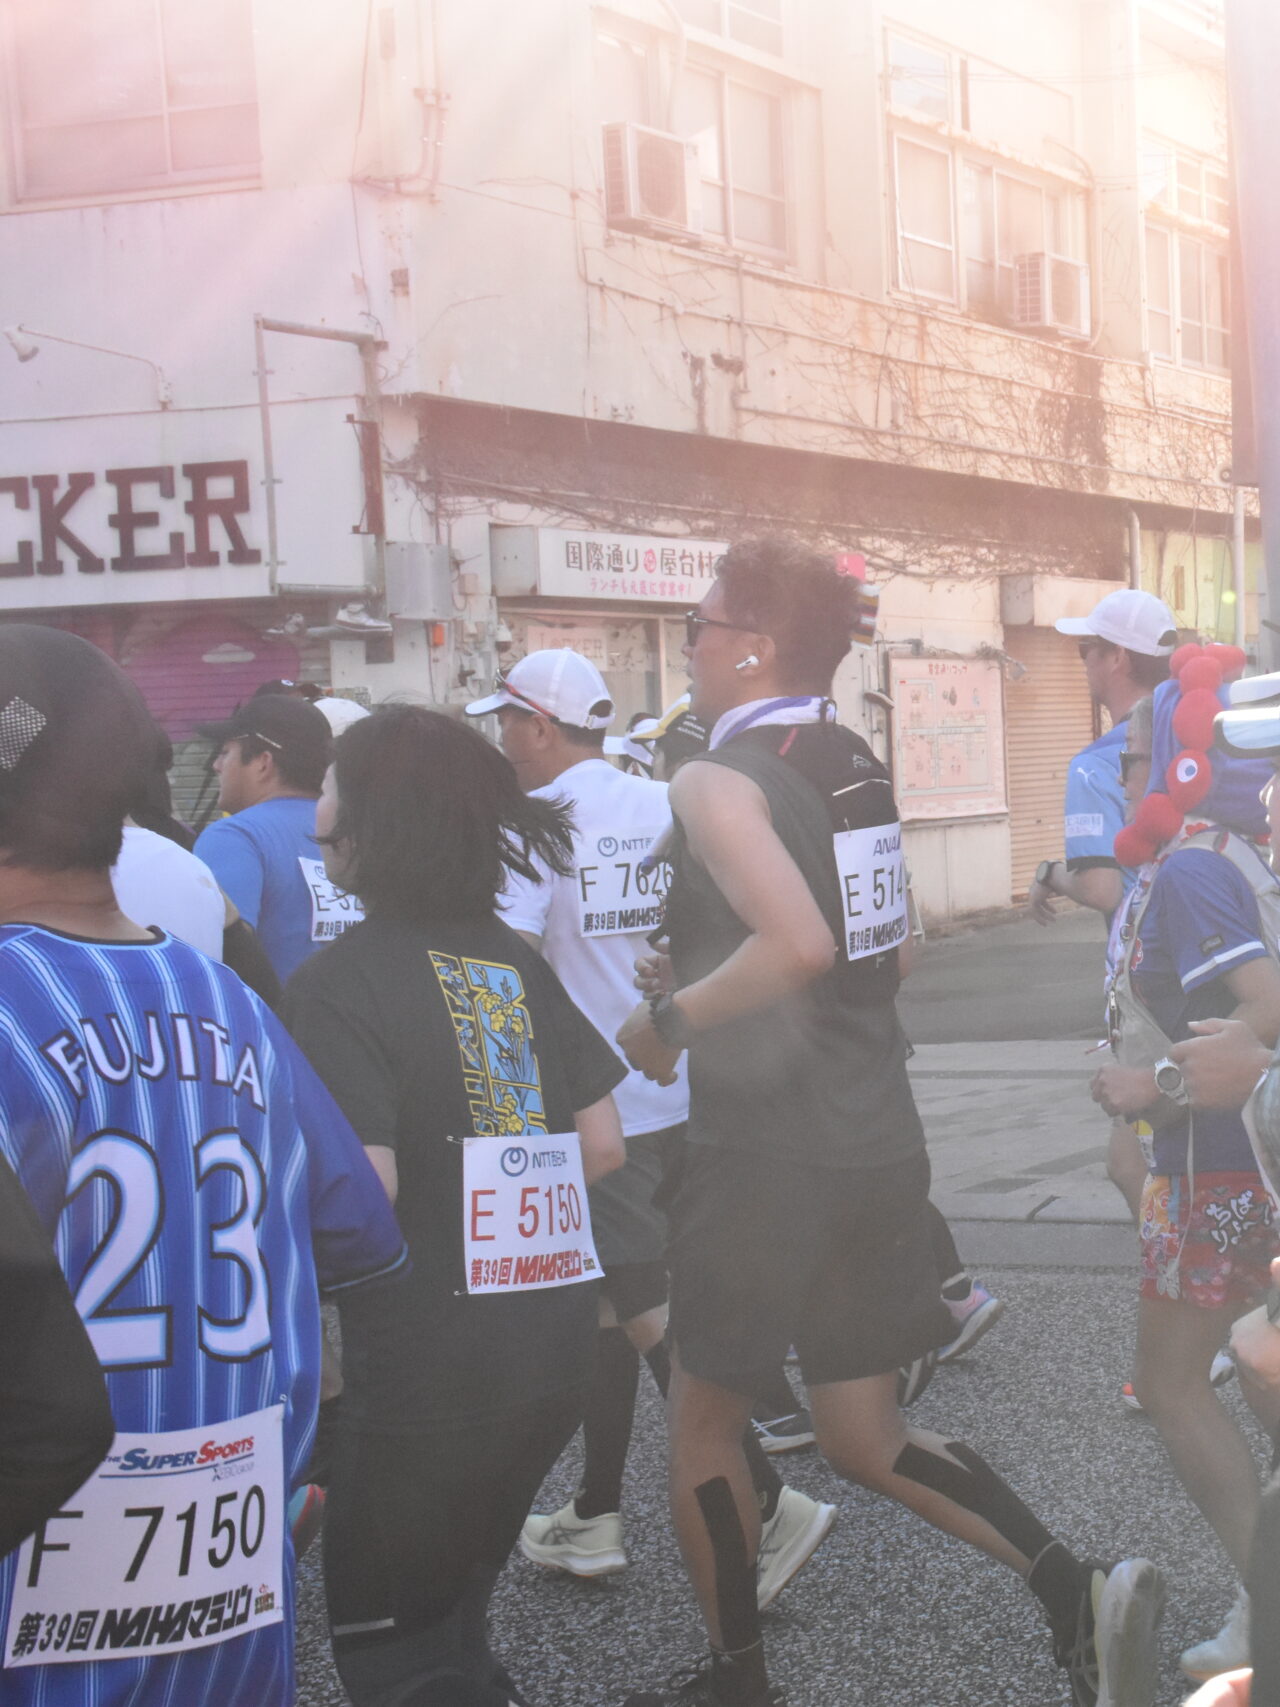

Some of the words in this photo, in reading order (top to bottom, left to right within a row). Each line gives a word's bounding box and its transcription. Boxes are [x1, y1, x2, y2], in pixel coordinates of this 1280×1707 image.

[579, 866, 599, 902] F
[844, 874, 863, 918] E
[872, 861, 904, 911] 514
[39, 1011, 267, 1114] FUJITA
[471, 1189, 497, 1242] E
[518, 1182, 582, 1239] 5150
[62, 1127, 273, 1373] 23
[471, 1256, 513, 1288] 第39回
[26, 1510, 84, 1588] F
[123, 1484, 266, 1583] 7150
[12, 1609, 100, 1658] 第39回
